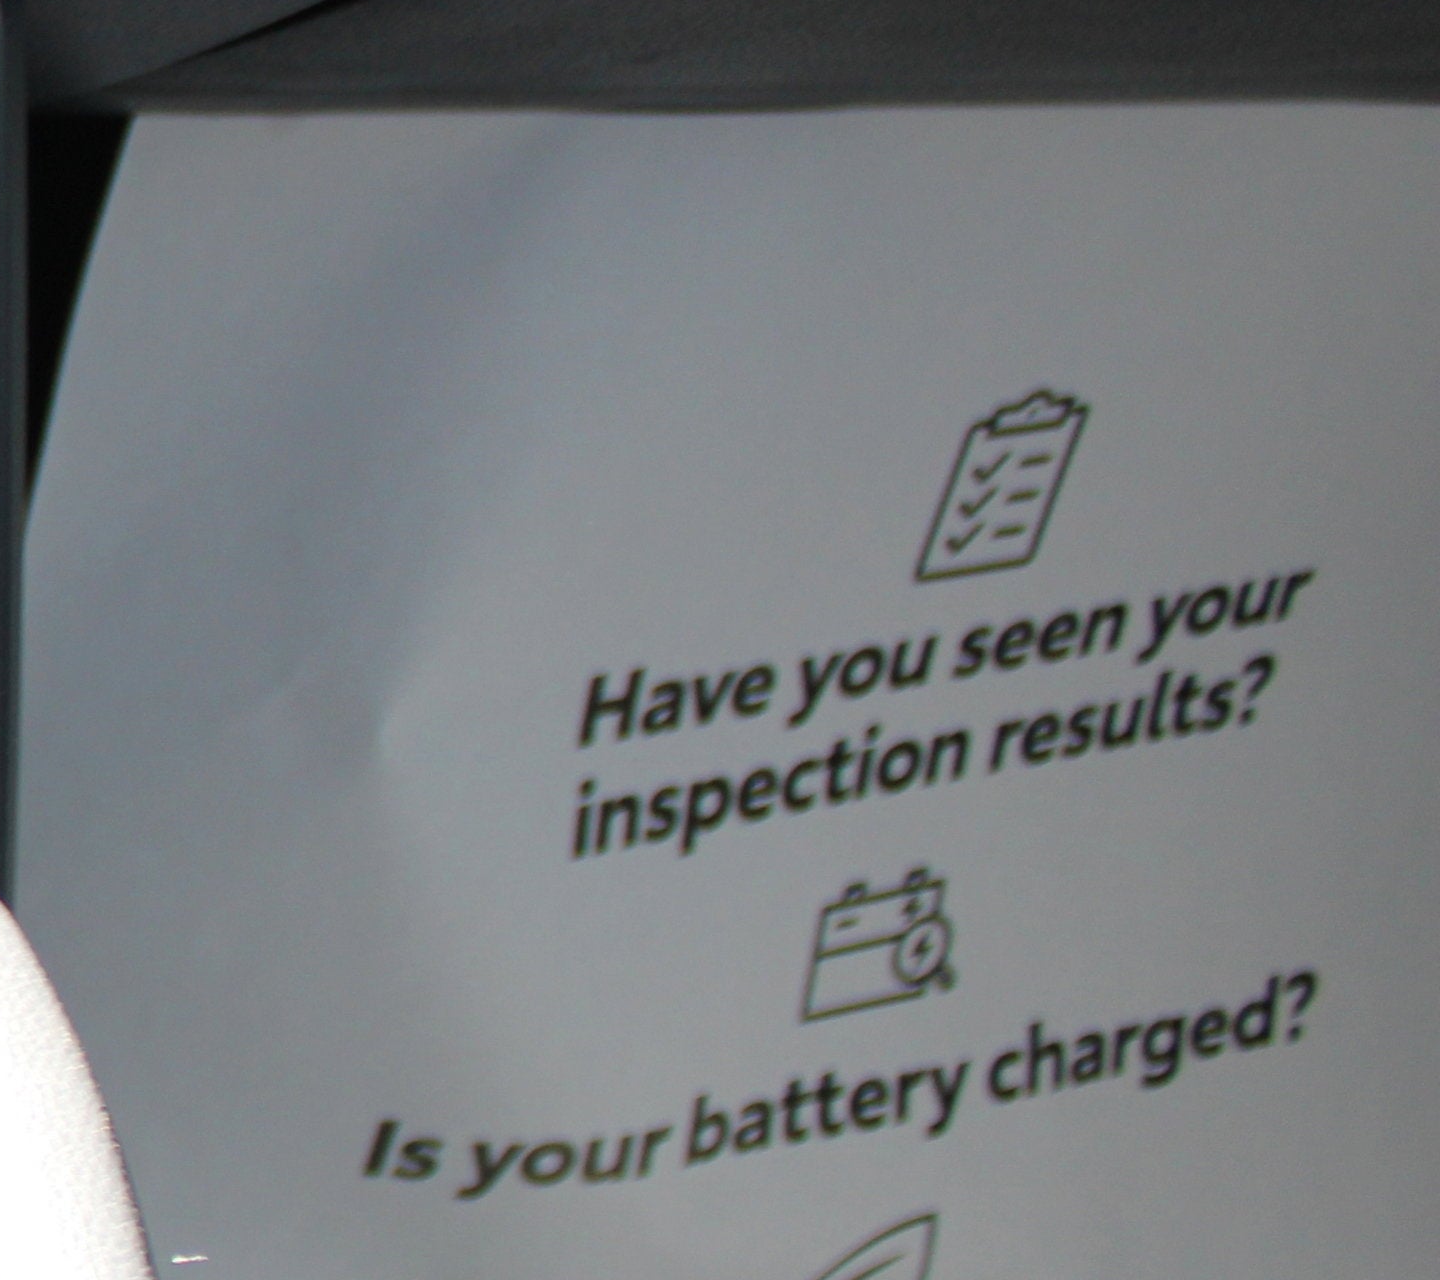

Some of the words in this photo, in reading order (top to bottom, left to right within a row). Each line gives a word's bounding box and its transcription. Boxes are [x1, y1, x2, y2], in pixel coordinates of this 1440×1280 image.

[572, 723, 970, 859] inspection
[988, 652, 1276, 770] results?
[577, 665, 777, 747] Have
[791, 629, 939, 722] you
[954, 599, 1126, 681] seen
[1138, 565, 1317, 660] your
[361, 1118, 442, 1181] Is
[457, 1124, 670, 1200] your
[685, 1055, 972, 1166] battery
[988, 968, 1320, 1103] charged?
